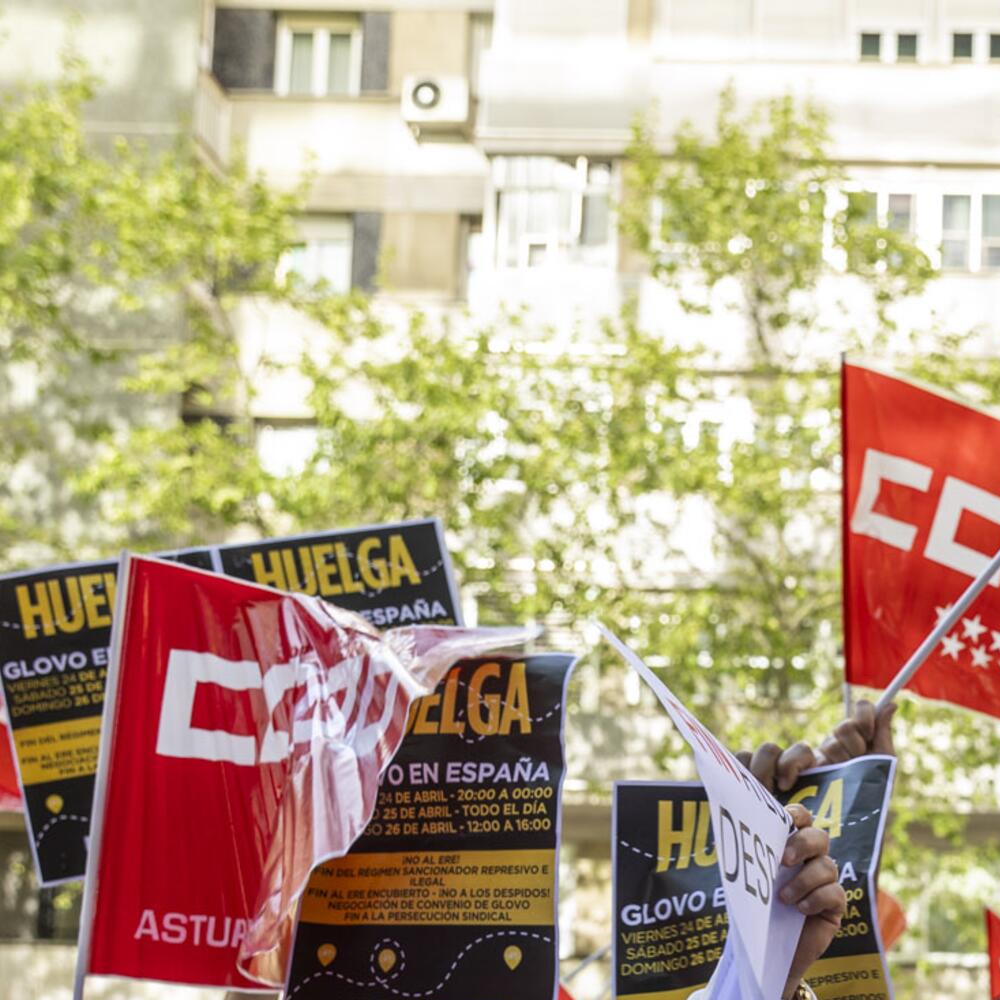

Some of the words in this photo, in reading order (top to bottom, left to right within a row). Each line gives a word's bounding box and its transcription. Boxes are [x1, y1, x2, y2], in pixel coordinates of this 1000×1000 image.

[251, 535, 422, 597] HUELGA
[3, 651, 87, 680] GLOVO
[405, 662, 532, 736] ELGA
[409, 762, 439, 785] EN
[445, 756, 550, 784] ESPAÑA
[394, 791, 414, 804] DE
[414, 789, 448, 804] ABRIL
[457, 788, 496, 801] 20:00
[498, 787, 509, 800] A
[511, 786, 553, 799] 00:00
[382, 807, 398, 819] 25
[399, 806, 418, 819] DE
[418, 805, 452, 818] ABRIL
[461, 803, 500, 817] TODO
[503, 802, 519, 815] EL
[522, 799, 547, 814] DÍA
[385, 823, 401, 836] 26
[402, 822, 420, 835] DE
[421, 820, 457, 834] ABRIL
[466, 819, 500, 832] 12:00
[503, 818, 514, 831] A
[517, 817, 551, 830] 16:00
[422, 854, 436, 865] AL
[336, 867, 357, 878] DEL
[402, 866, 480, 876] SANCIONADOR
[481, 865, 539, 875] REPRESIVO
[409, 877, 446, 887] ILEGAL
[330, 888, 345, 898] AL
[367, 888, 430, 898] ENCUBIERTO
[469, 888, 491, 898] LOS
[492, 888, 551, 898] DESPIDOS!
[400, 900, 415, 910] DE
[417, 900, 473, 910] CONVENIO
[475, 900, 490, 909] DE
[491, 899, 531, 910] GLOVO
[620, 890, 706, 927] GLOVO
[344, 911, 361, 922] FIN
[371, 911, 385, 921] LA
[388, 910, 461, 921] PERSECUCIÓN
[463, 911, 513, 921] SINDICAL
[620, 922, 679, 945] VIERNES
[695, 916, 714, 931] DE
[625, 939, 686, 961] SÁBADO
[686, 935, 702, 951] 25
[702, 931, 719, 946] DE
[620, 957, 689, 977] DOMINGO
[690, 951, 705, 967] 26
[705, 946, 722, 962] DE
